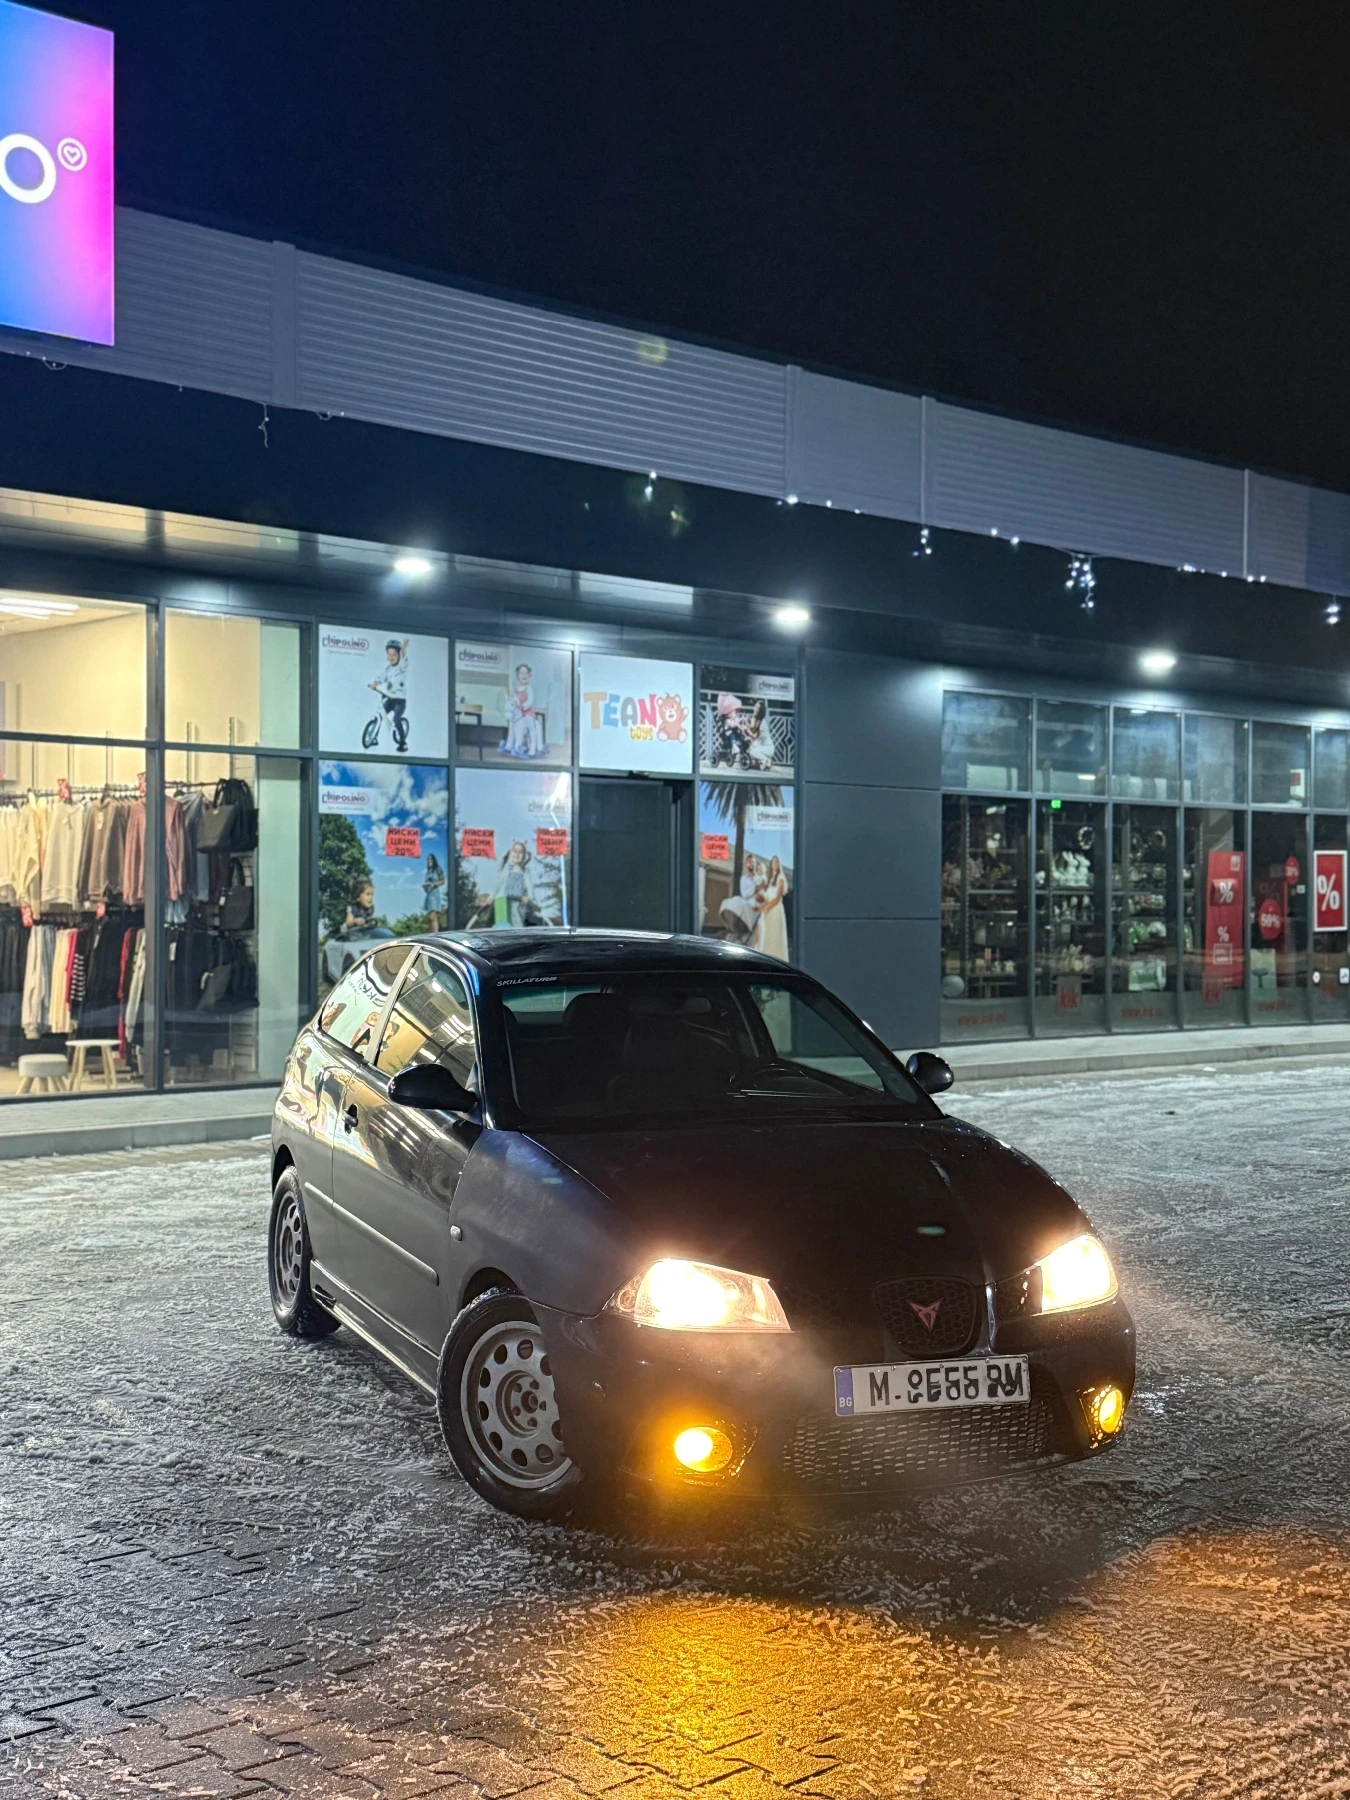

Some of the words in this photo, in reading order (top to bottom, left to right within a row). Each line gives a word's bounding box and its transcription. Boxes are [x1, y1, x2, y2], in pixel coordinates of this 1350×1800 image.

[583, 691, 657, 730] TEAN
[388, 828, 419, 836] НИСКИ
[464, 829, 494, 837] НИСКИ
[391, 837, 416, 846] ЦЕНИ
[467, 839, 491, 847] ЦЕНИ
[392, 847, 415, 856] -20%
[1260, 914, 1280, 929] 50%
[838, 1397, 853, 1408] BG
